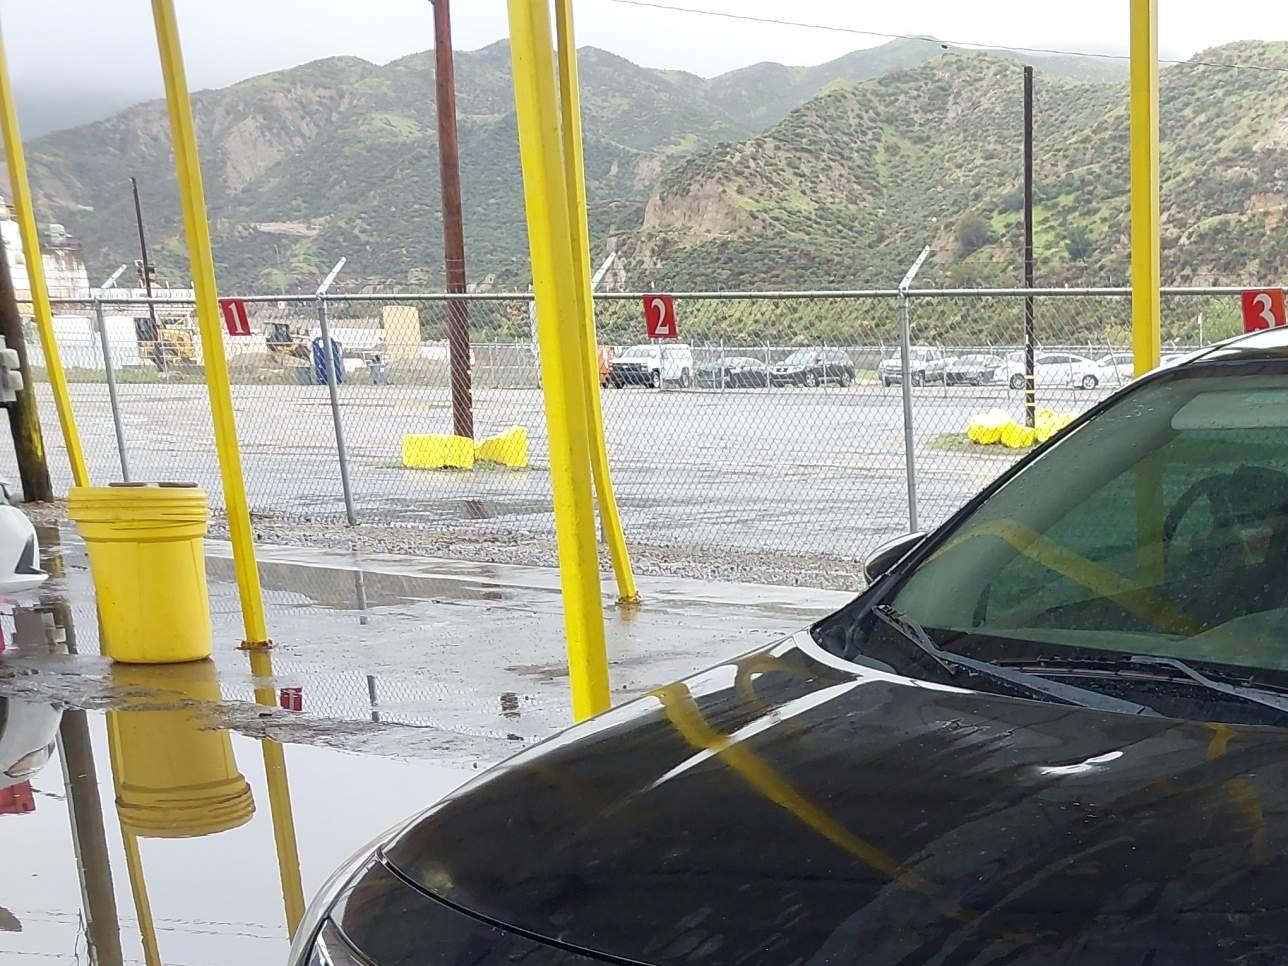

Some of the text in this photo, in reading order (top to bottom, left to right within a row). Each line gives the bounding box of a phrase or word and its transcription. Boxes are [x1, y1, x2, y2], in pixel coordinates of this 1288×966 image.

[229, 302, 246, 334] 1
[651, 298, 669, 335] 2
[1252, 293, 1276, 331] 3
